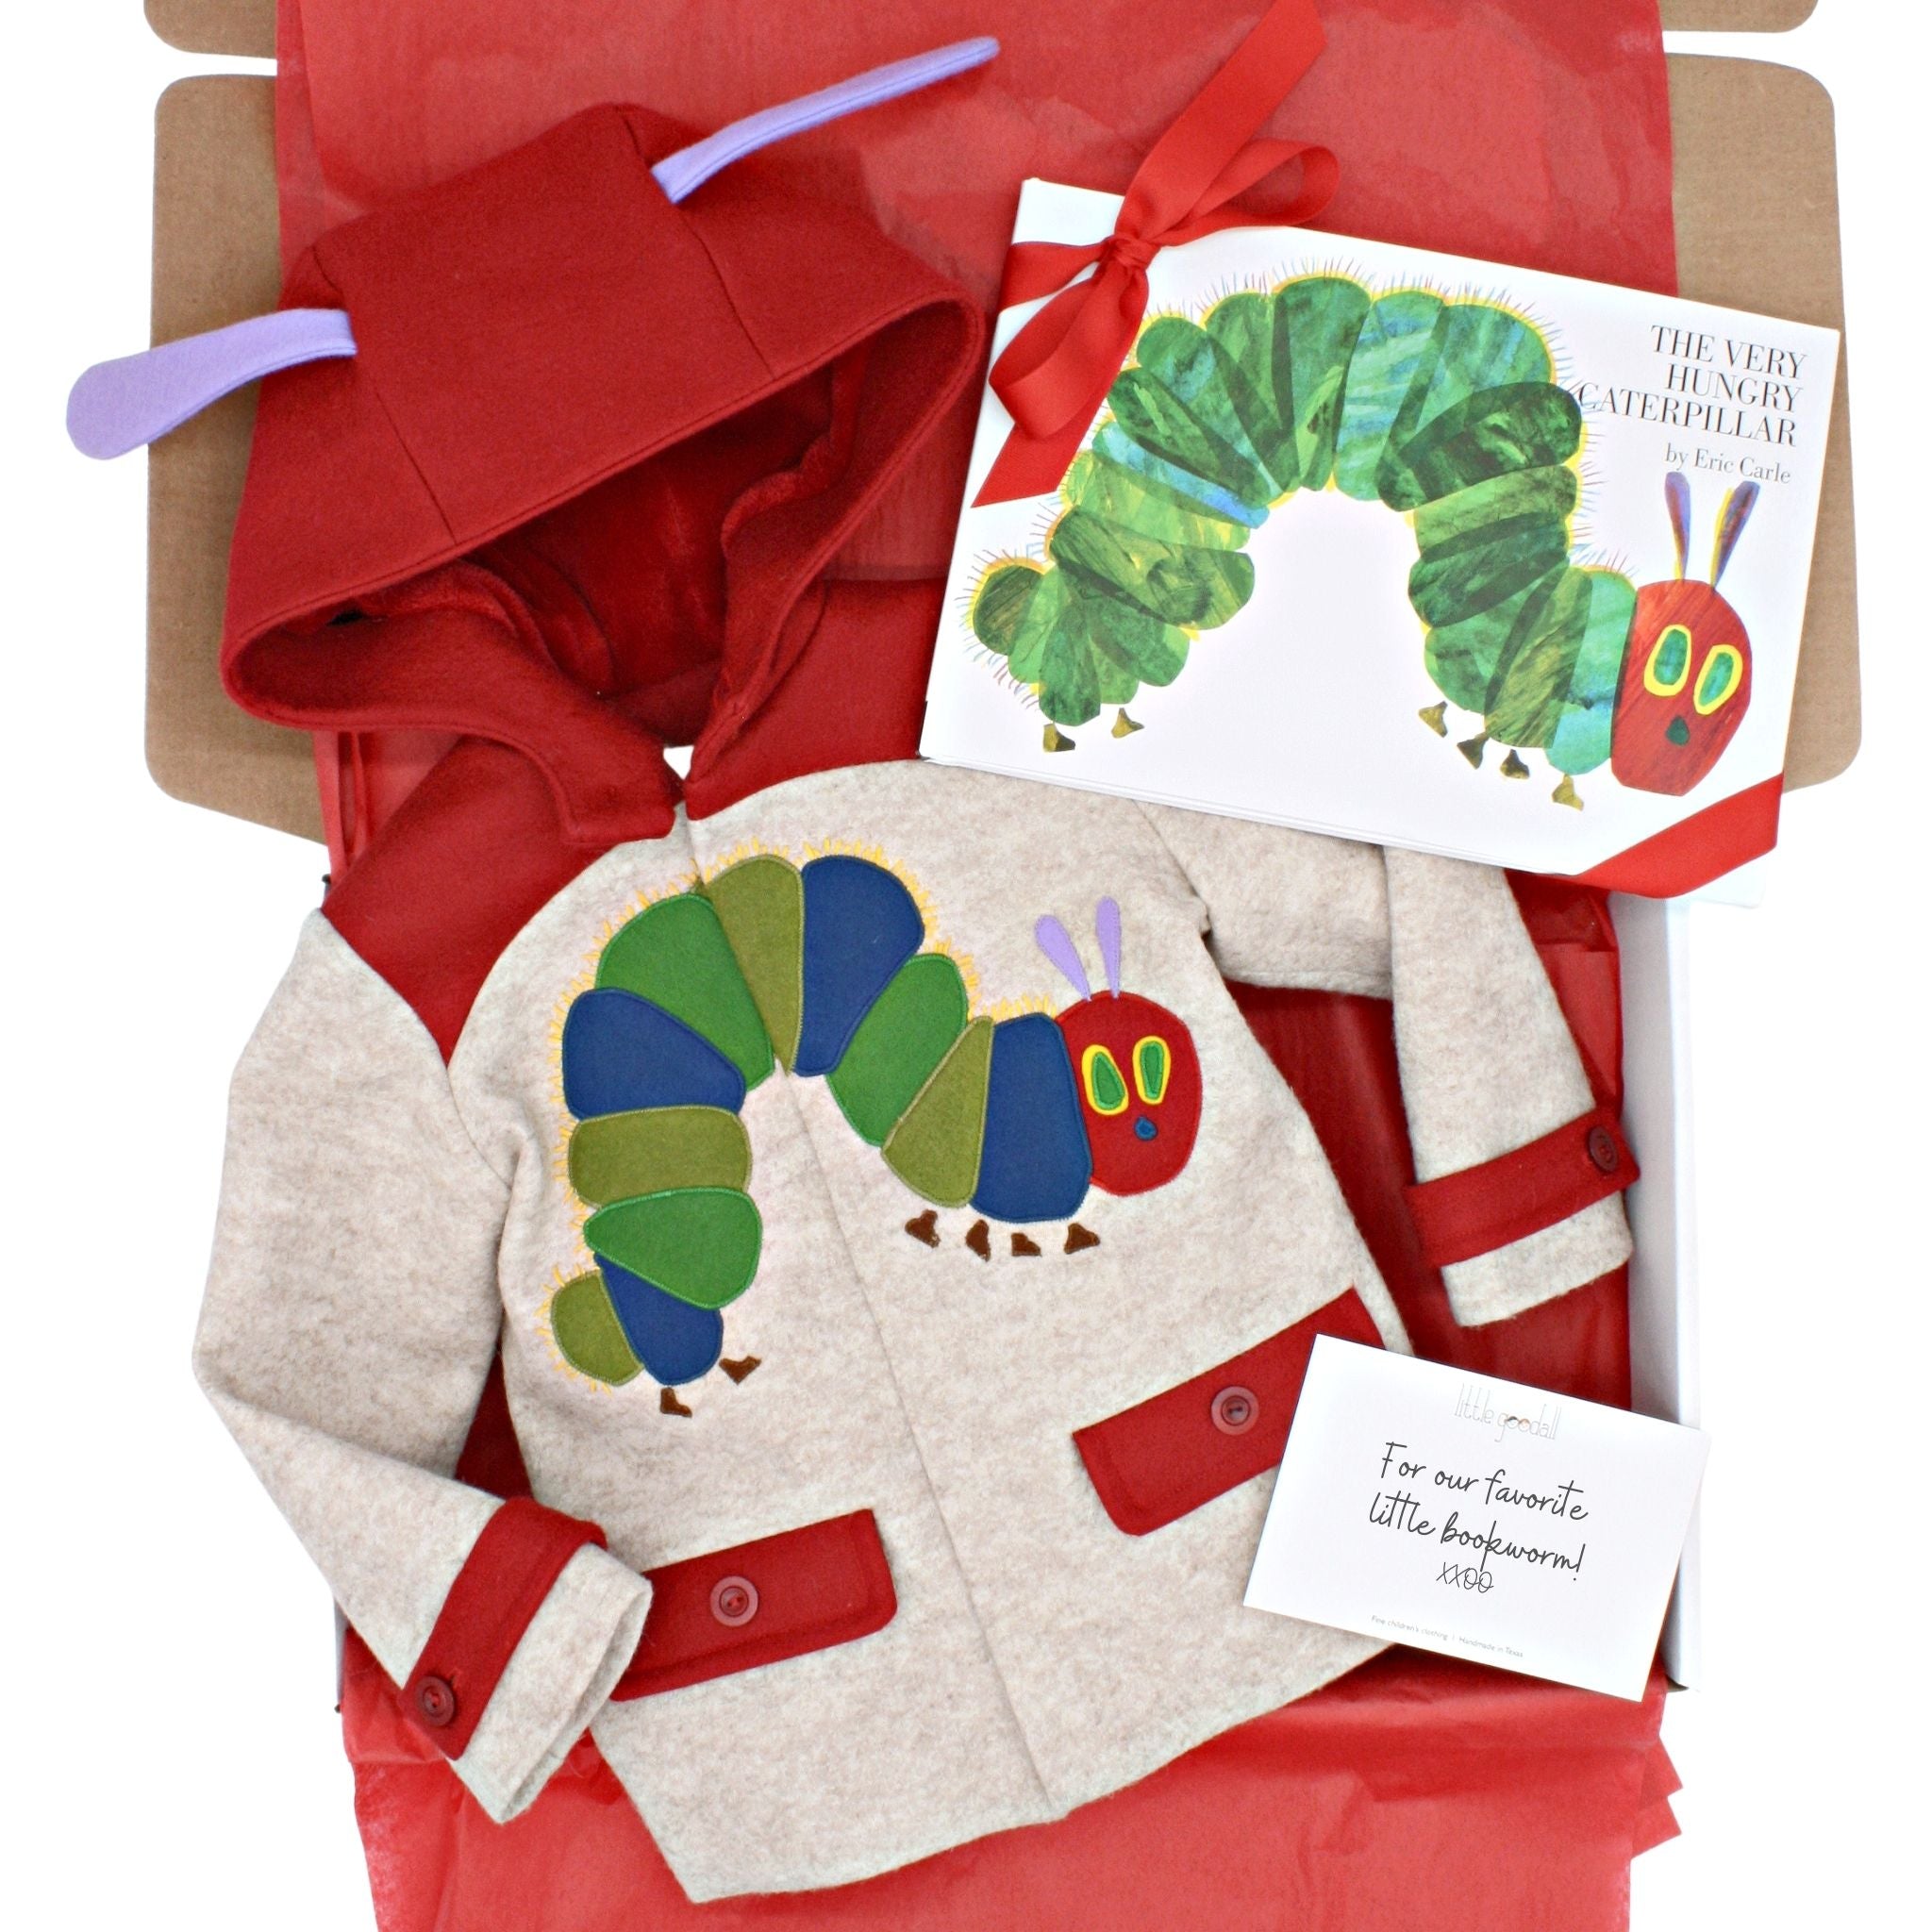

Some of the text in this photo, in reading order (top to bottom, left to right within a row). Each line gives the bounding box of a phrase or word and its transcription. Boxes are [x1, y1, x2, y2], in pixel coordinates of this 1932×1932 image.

[1651, 325, 1807, 379] THE VERY
[1578, 382, 1796, 447] CATERPILLAR
[1664, 363, 1804, 413] HUNGRY
[1664, 442, 1790, 484] by Eric Carle
[1454, 1383, 1561, 1442] little goodall
[1381, 1441, 1589, 1521] For our favorite
[1370, 1491, 1586, 1581] little bookworm!
[1371, 1614, 1385, 1624] Fine
[1422, 1627, 1448, 1641] clothing
[1458, 1637, 1495, 1651] Handmade
[1506, 1646, 1524, 1657] Texas
